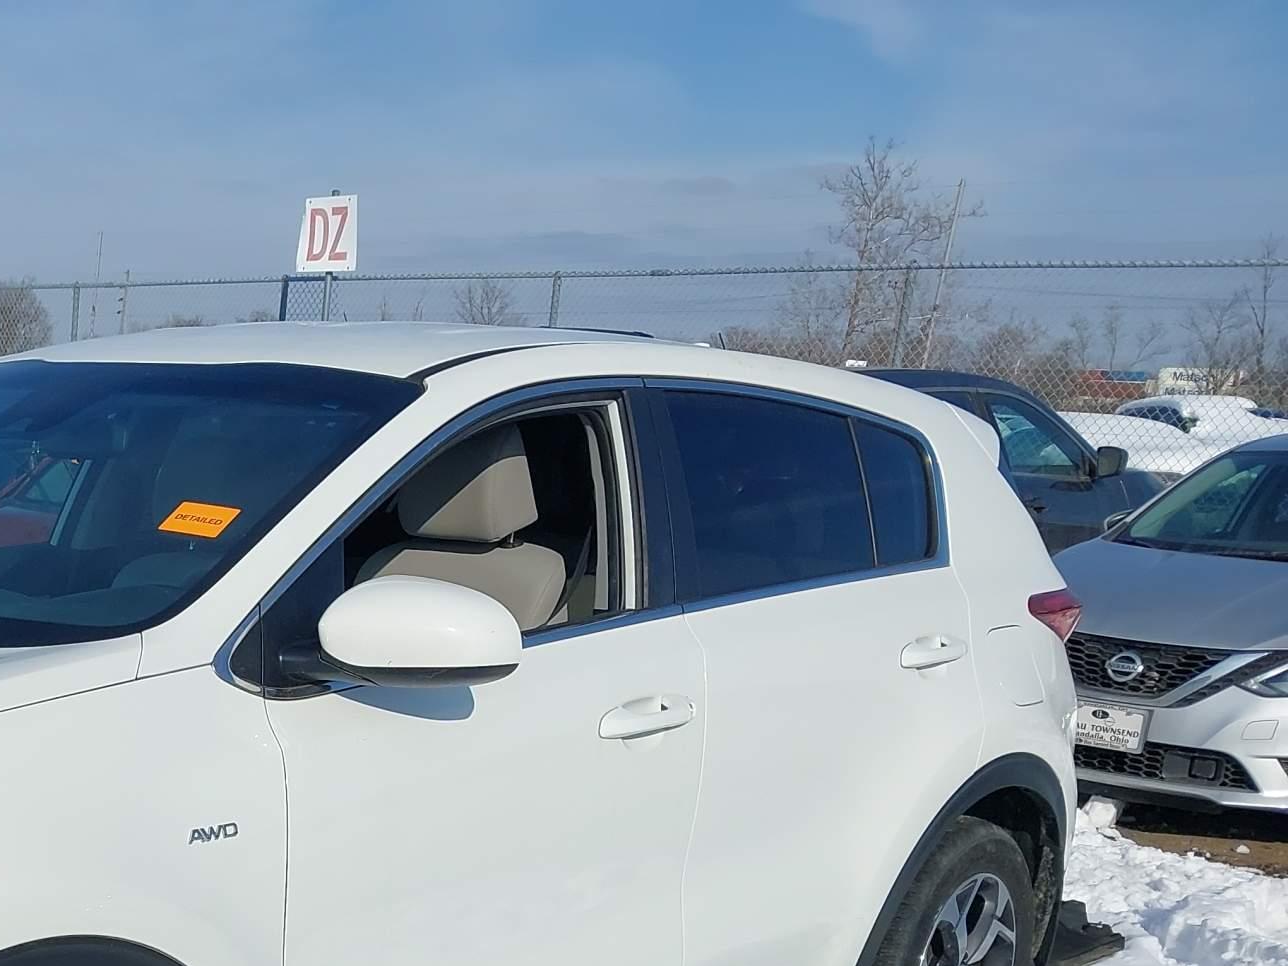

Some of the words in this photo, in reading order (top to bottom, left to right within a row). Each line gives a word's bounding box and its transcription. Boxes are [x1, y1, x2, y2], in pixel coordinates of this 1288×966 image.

[306, 206, 348, 261] DZ
[174, 513, 223, 526] DETAILED
[1091, 724, 1139, 738] TOWNSEND
[188, 822, 238, 845] AWD
